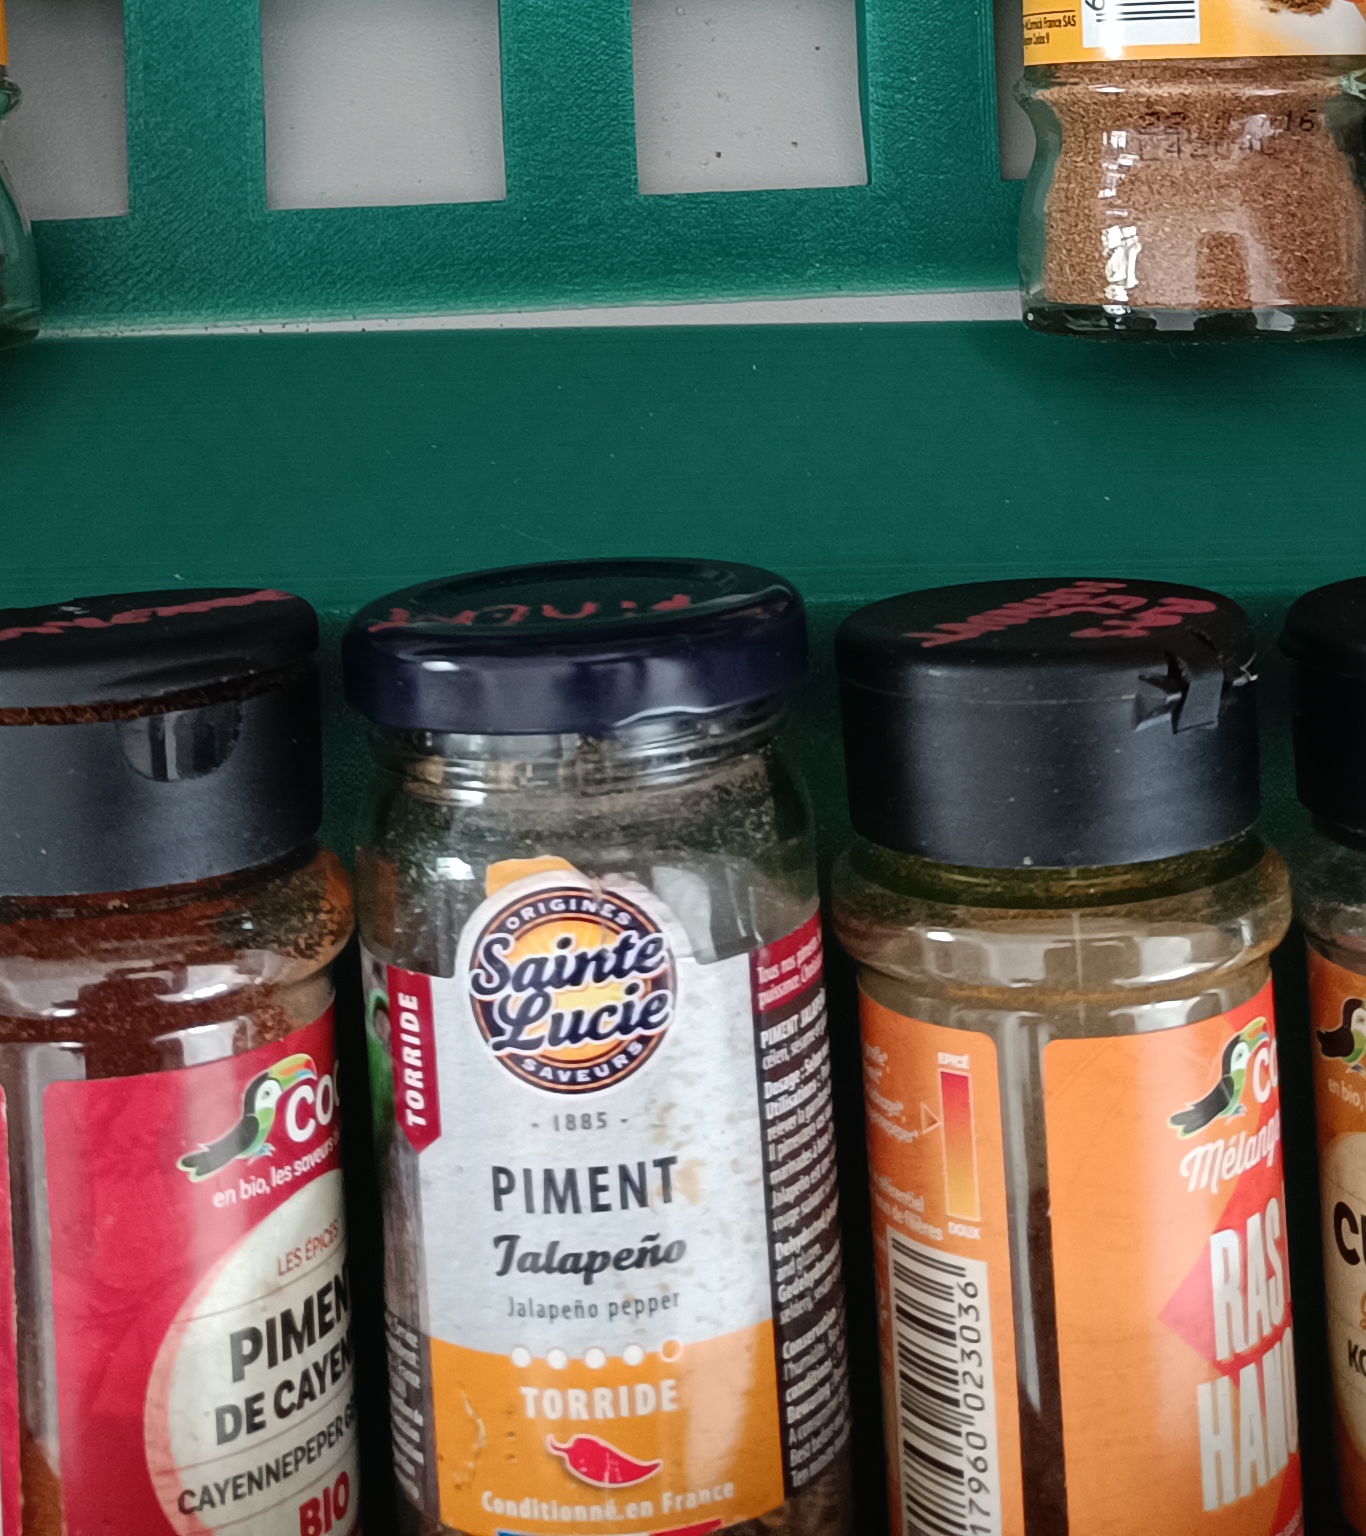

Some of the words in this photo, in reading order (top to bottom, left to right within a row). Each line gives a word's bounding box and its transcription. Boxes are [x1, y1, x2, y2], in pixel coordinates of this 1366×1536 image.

[503, 896, 634, 931] ORIGINES
[469, 931, 668, 998] Sainte
[487, 982, 672, 1053] Lucie
[405, 991, 429, 1128] TORRIDE
[520, 1039, 645, 1084] SAVEURS
[270, 1163, 292, 1187] les
[491, 1156, 679, 1216] PIMENT
[492, 1233, 688, 1286] Jalapeño
[1209, 1197, 1285, 1362] RAS
[506, 1296, 600, 1324] Jalapeño
[608, 1291, 681, 1322] pepper
[957, 1278, 986, 1412] 023036
[214, 1391, 267, 1446] DE
[519, 1378, 680, 1422] TORRIDE
[177, 1417, 344, 1515] CAYENNEPEPER
[299, 1469, 351, 1536] BIO
[480, 1489, 625, 1522] Conditionné
[625, 1500, 655, 1520] en
[661, 1481, 737, 1513] France
